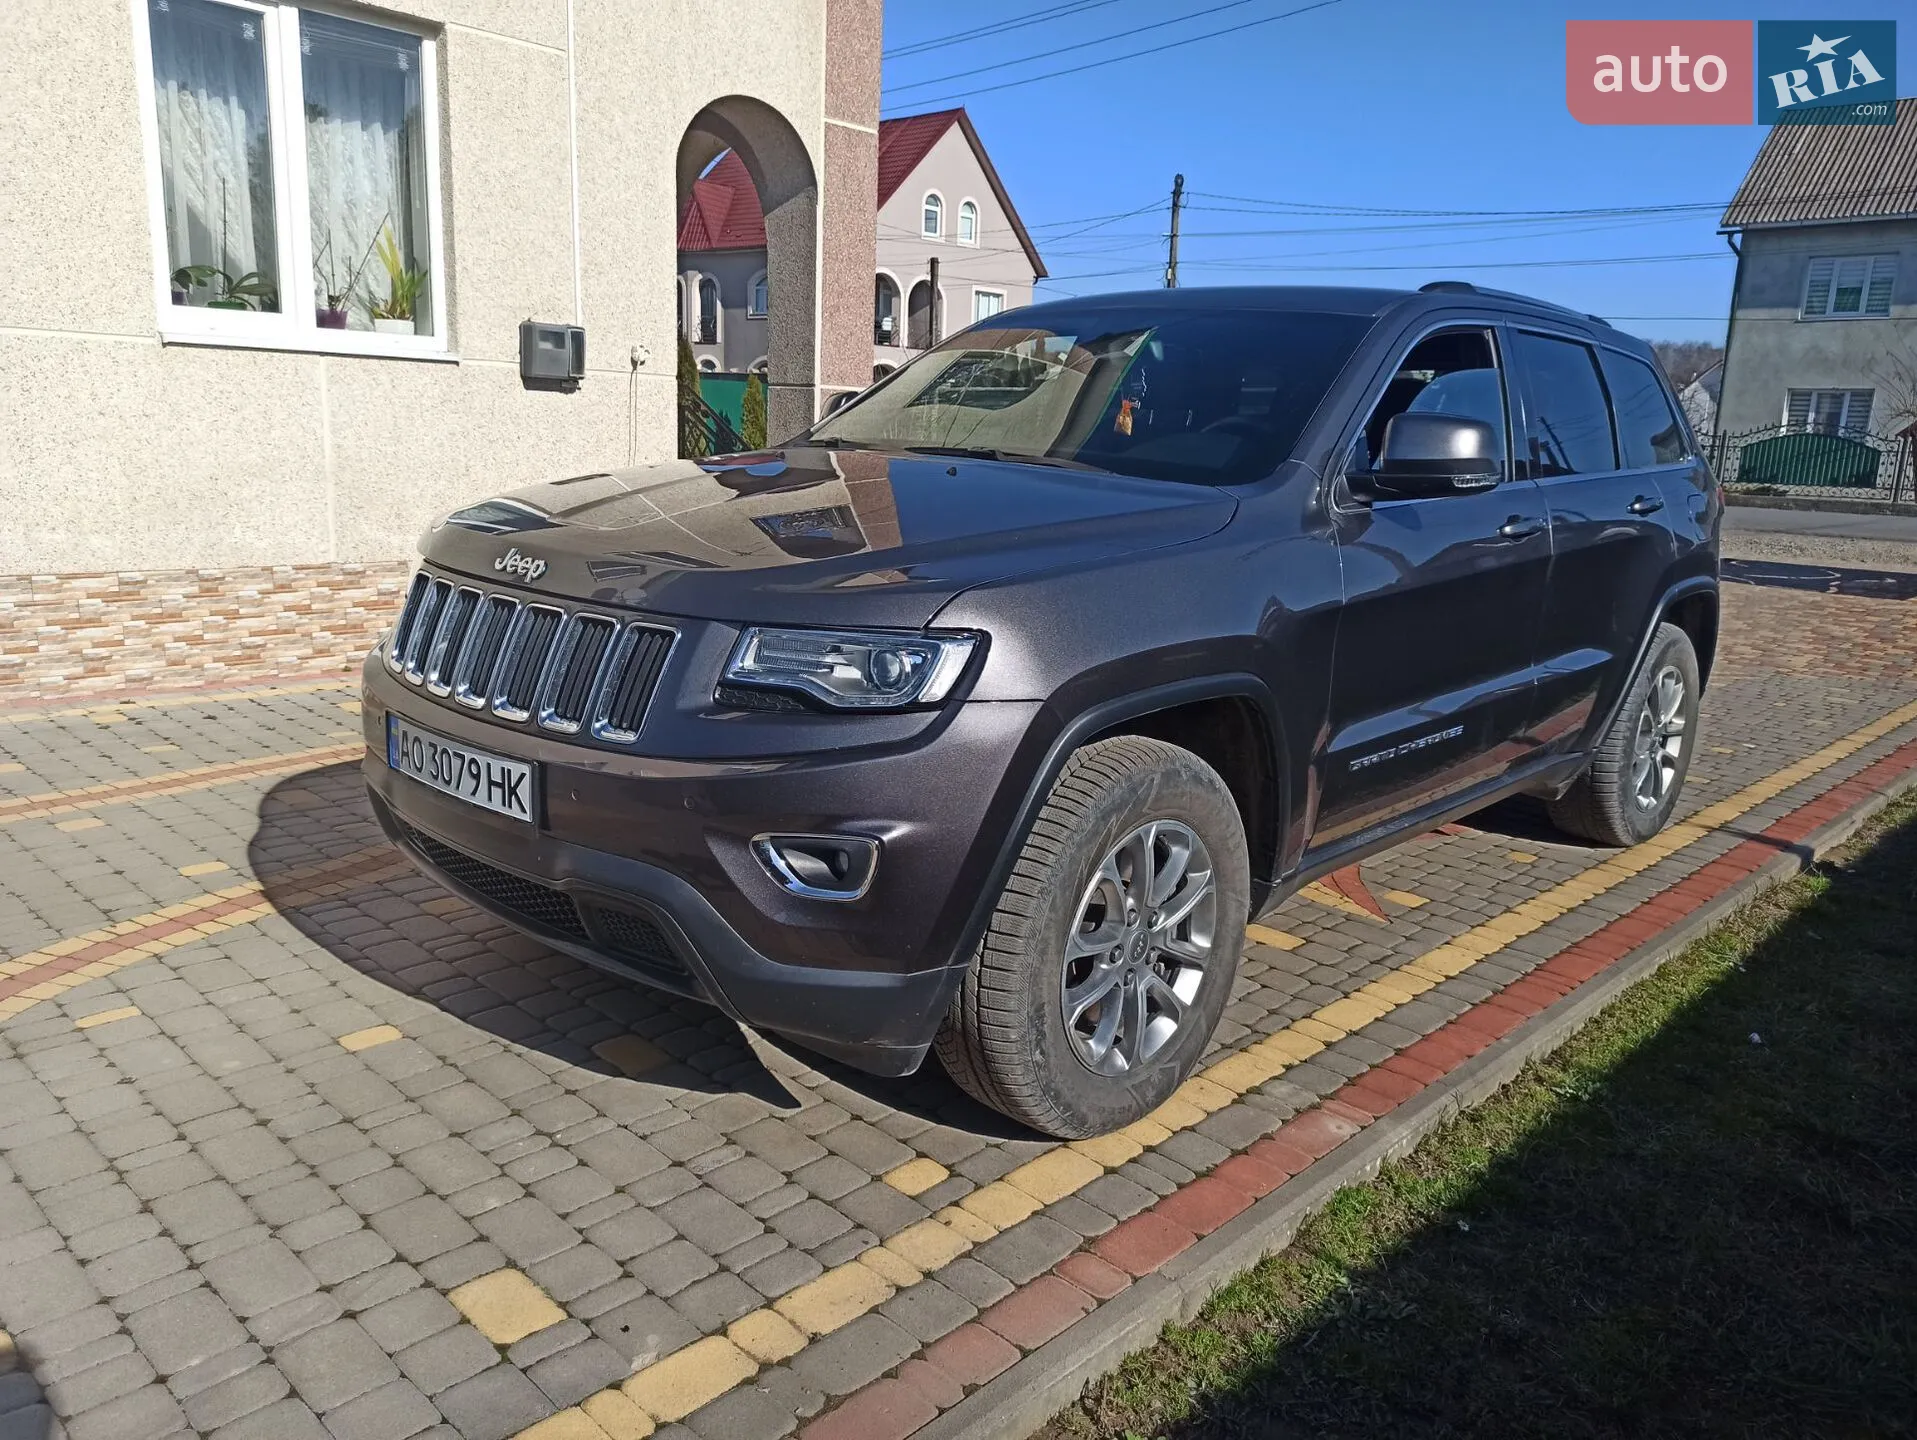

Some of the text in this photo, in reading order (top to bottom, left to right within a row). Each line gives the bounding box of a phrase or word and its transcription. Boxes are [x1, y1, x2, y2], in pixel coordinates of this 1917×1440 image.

[494, 547, 546, 584] Jeep
[400, 729, 528, 815] AO 3079 HK
